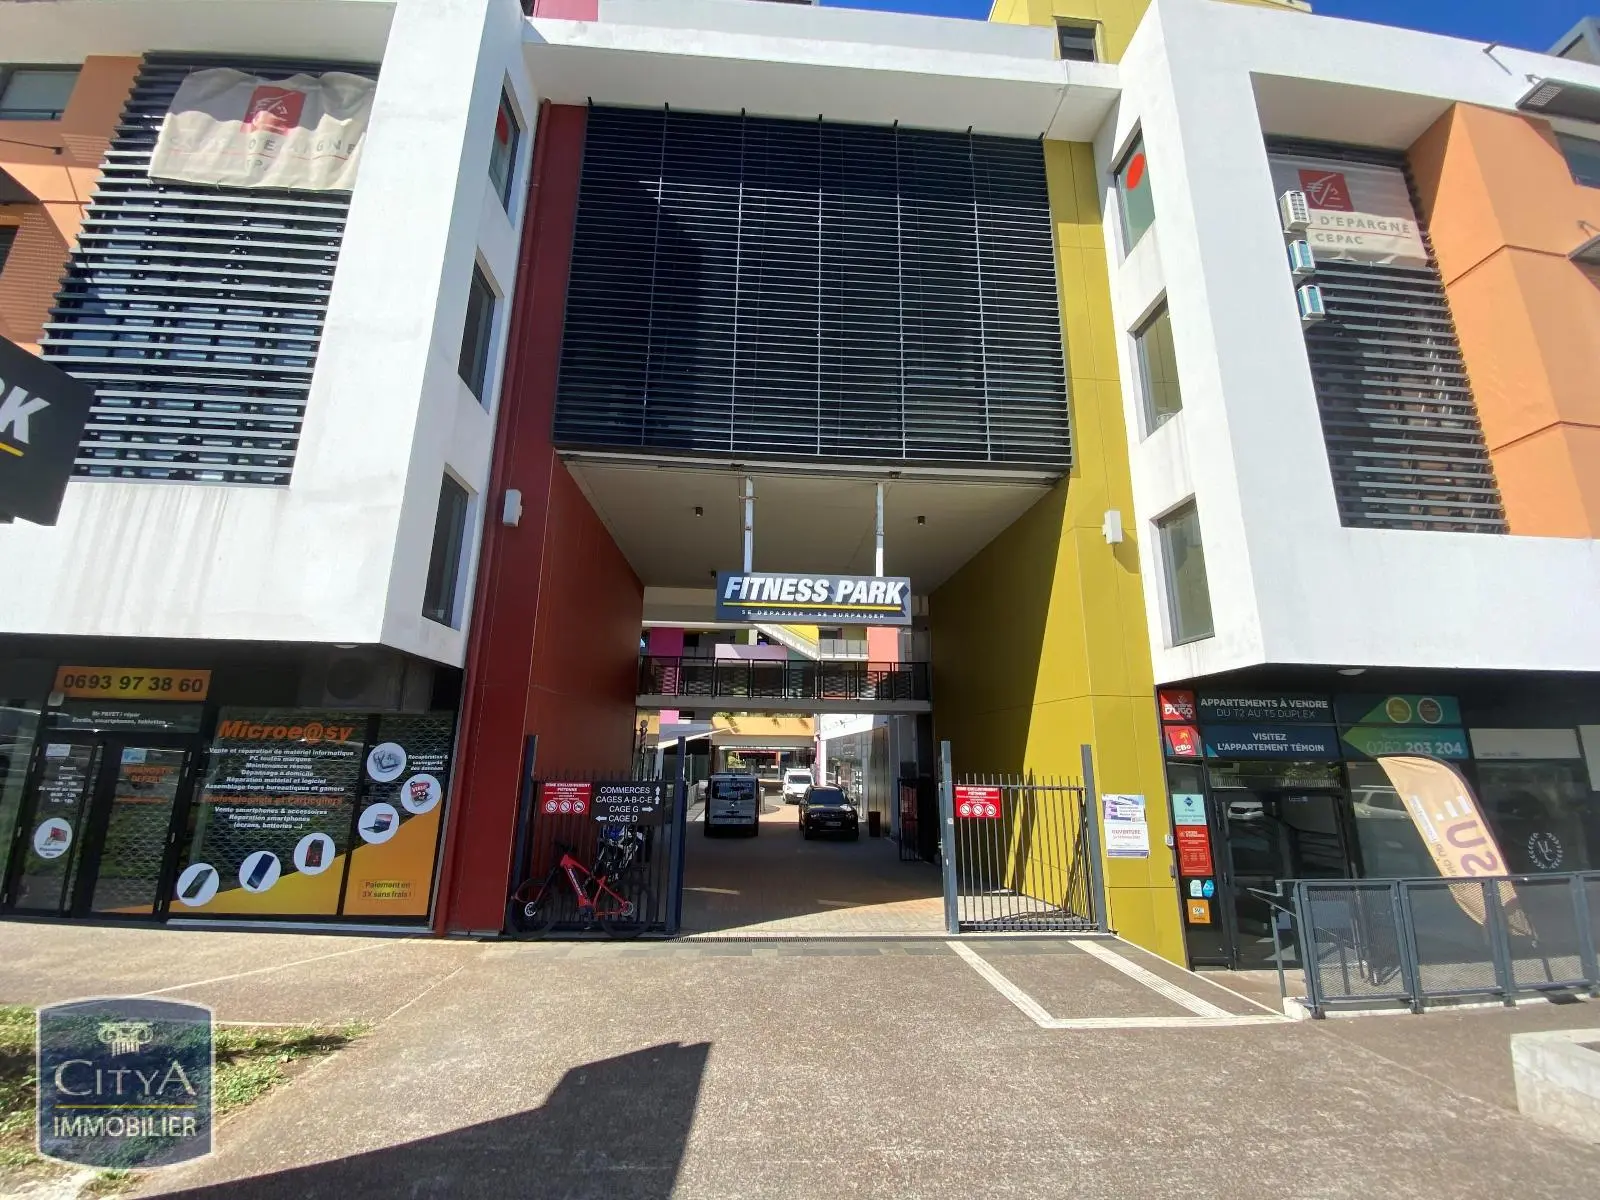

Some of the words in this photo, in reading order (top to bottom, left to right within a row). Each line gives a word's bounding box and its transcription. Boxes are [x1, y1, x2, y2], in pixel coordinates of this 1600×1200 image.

[1320, 215, 1410, 233] D'EPARGNE
[1316, 233, 1363, 245] CEPAC
[724, 577, 830, 603] FITNESS
[832, 580, 906, 605] PARK
[63, 674, 112, 690] 0693
[119, 676, 144, 690] 97
[148, 676, 173, 691] 38
[179, 678, 204, 693] 60
[1201, 698, 1278, 708] APPARTEMENTS
[1280, 697, 1287, 708] À
[1289, 700, 1329, 708] VENDRE
[1216, 709, 1231, 717] DU
[1233, 709, 1245, 717] T2
[1247, 709, 1261, 718] AU
[1264, 709, 1275, 718] T5
[1278, 710, 1316, 718] DUPLEX
[218, 720, 354, 745] Microe@sy
[1252, 732, 1287, 741] VISITEZ
[1217, 743, 1288, 752] L'APPARTEMENT
[1291, 742, 1325, 752] TÉMOIN
[1405, 742, 1433, 754] 203
[1435, 742, 1463, 754] 204
[600, 786, 651, 794] COMMERCES
[624, 796, 652, 804] A-B-C-E
[609, 805, 631, 813] CAGE
